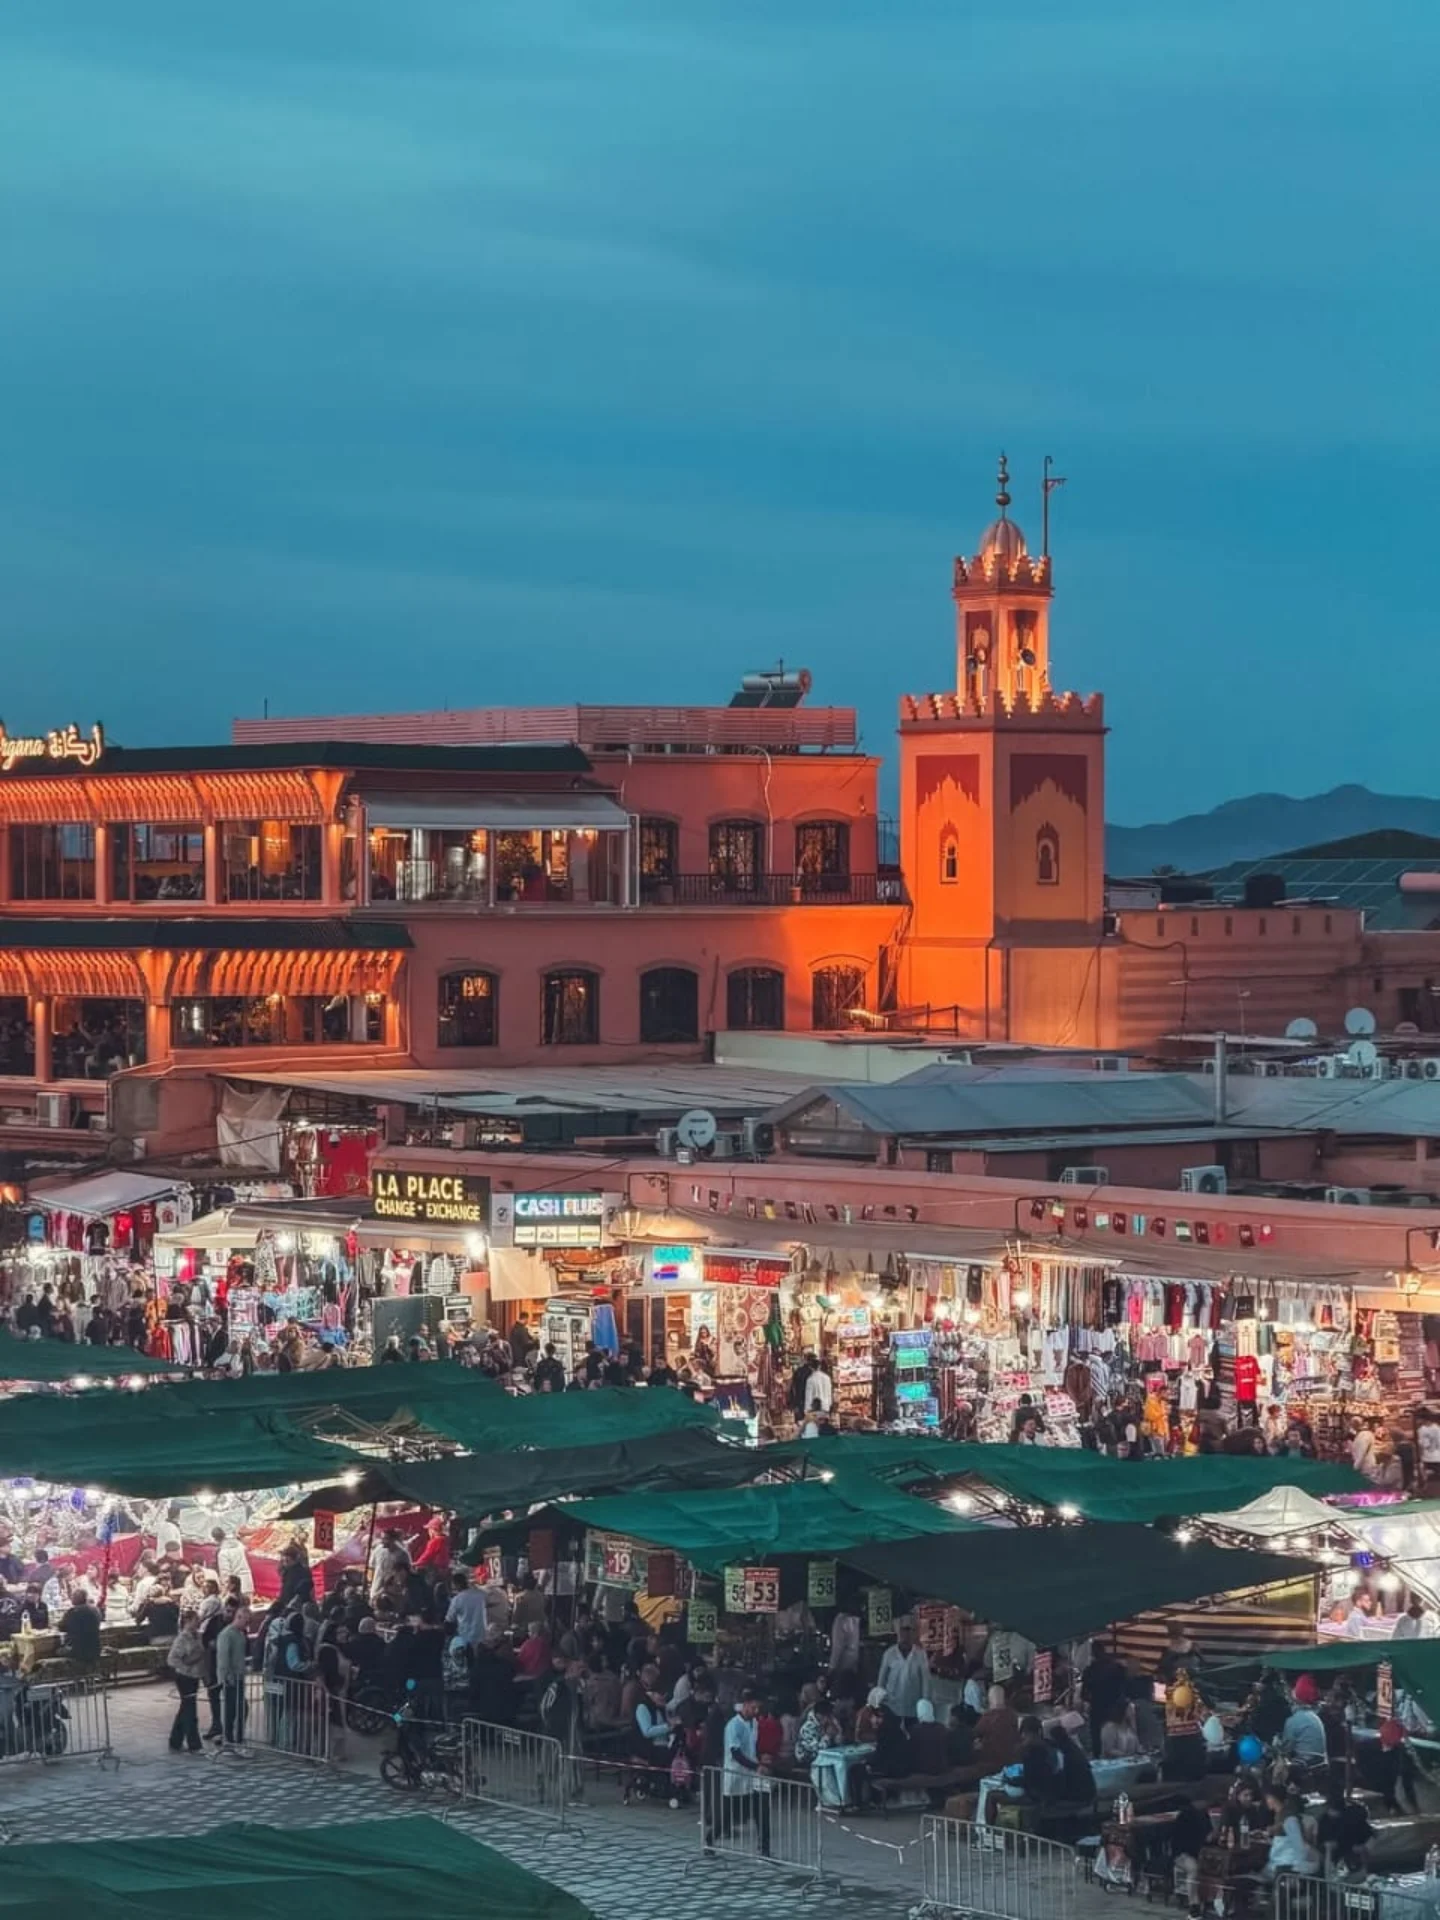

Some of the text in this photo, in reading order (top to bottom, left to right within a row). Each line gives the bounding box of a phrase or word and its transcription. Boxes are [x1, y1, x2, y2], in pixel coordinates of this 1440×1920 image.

[0, 725, 45, 770] rgana
[377, 1173, 464, 1201] LA PLACE
[374, 1197, 481, 1222] CHANGE EXCHANGE
[515, 1198, 604, 1216] CASH PLUS
[614, 1552, 631, 1574] 19
[753, 1582, 776, 1602] 53
[815, 1578, 834, 1596] 53
[696, 1613, 715, 1631] 53
